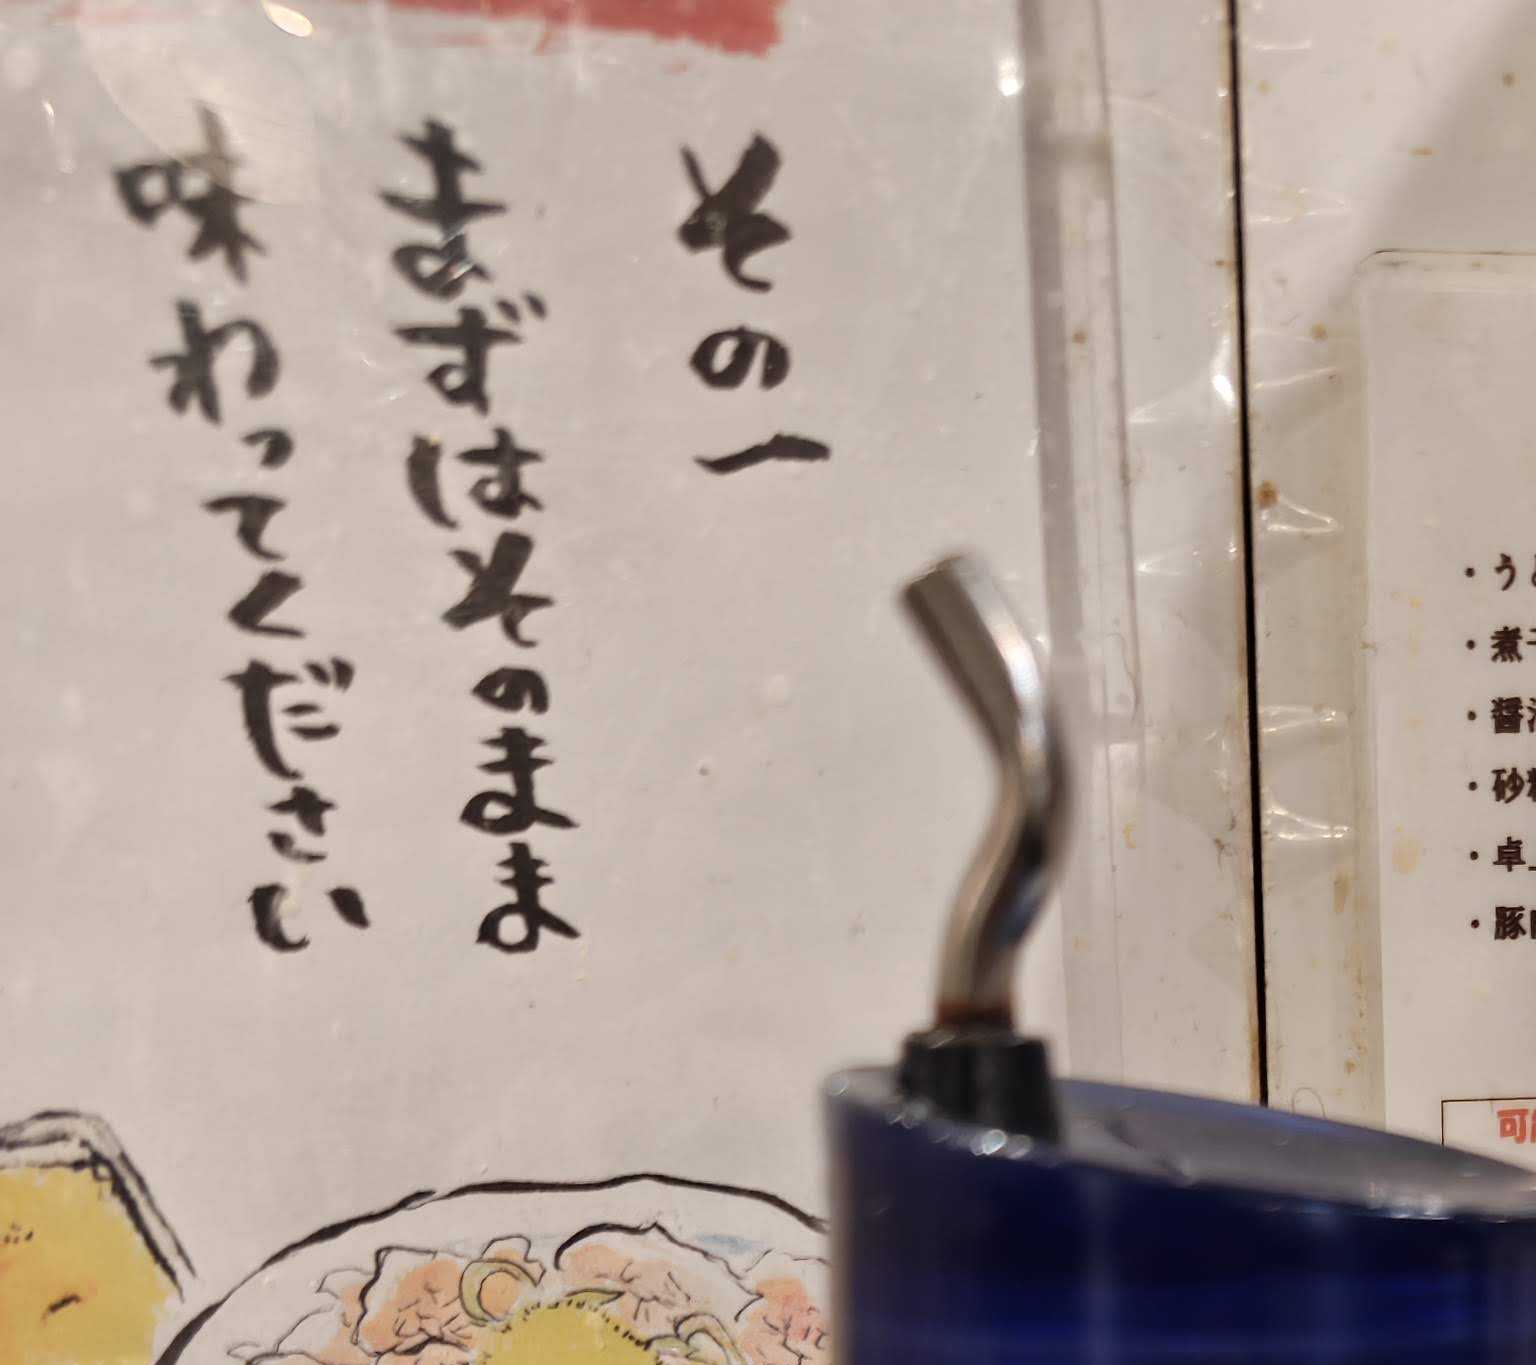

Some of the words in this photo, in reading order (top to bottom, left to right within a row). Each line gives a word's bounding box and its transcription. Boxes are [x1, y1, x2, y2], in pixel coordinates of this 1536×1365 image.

[109, 108, 372, 954] 味わってください
[377, 116, 582, 955] まずはそのまま
[676, 132, 832, 476] その一
